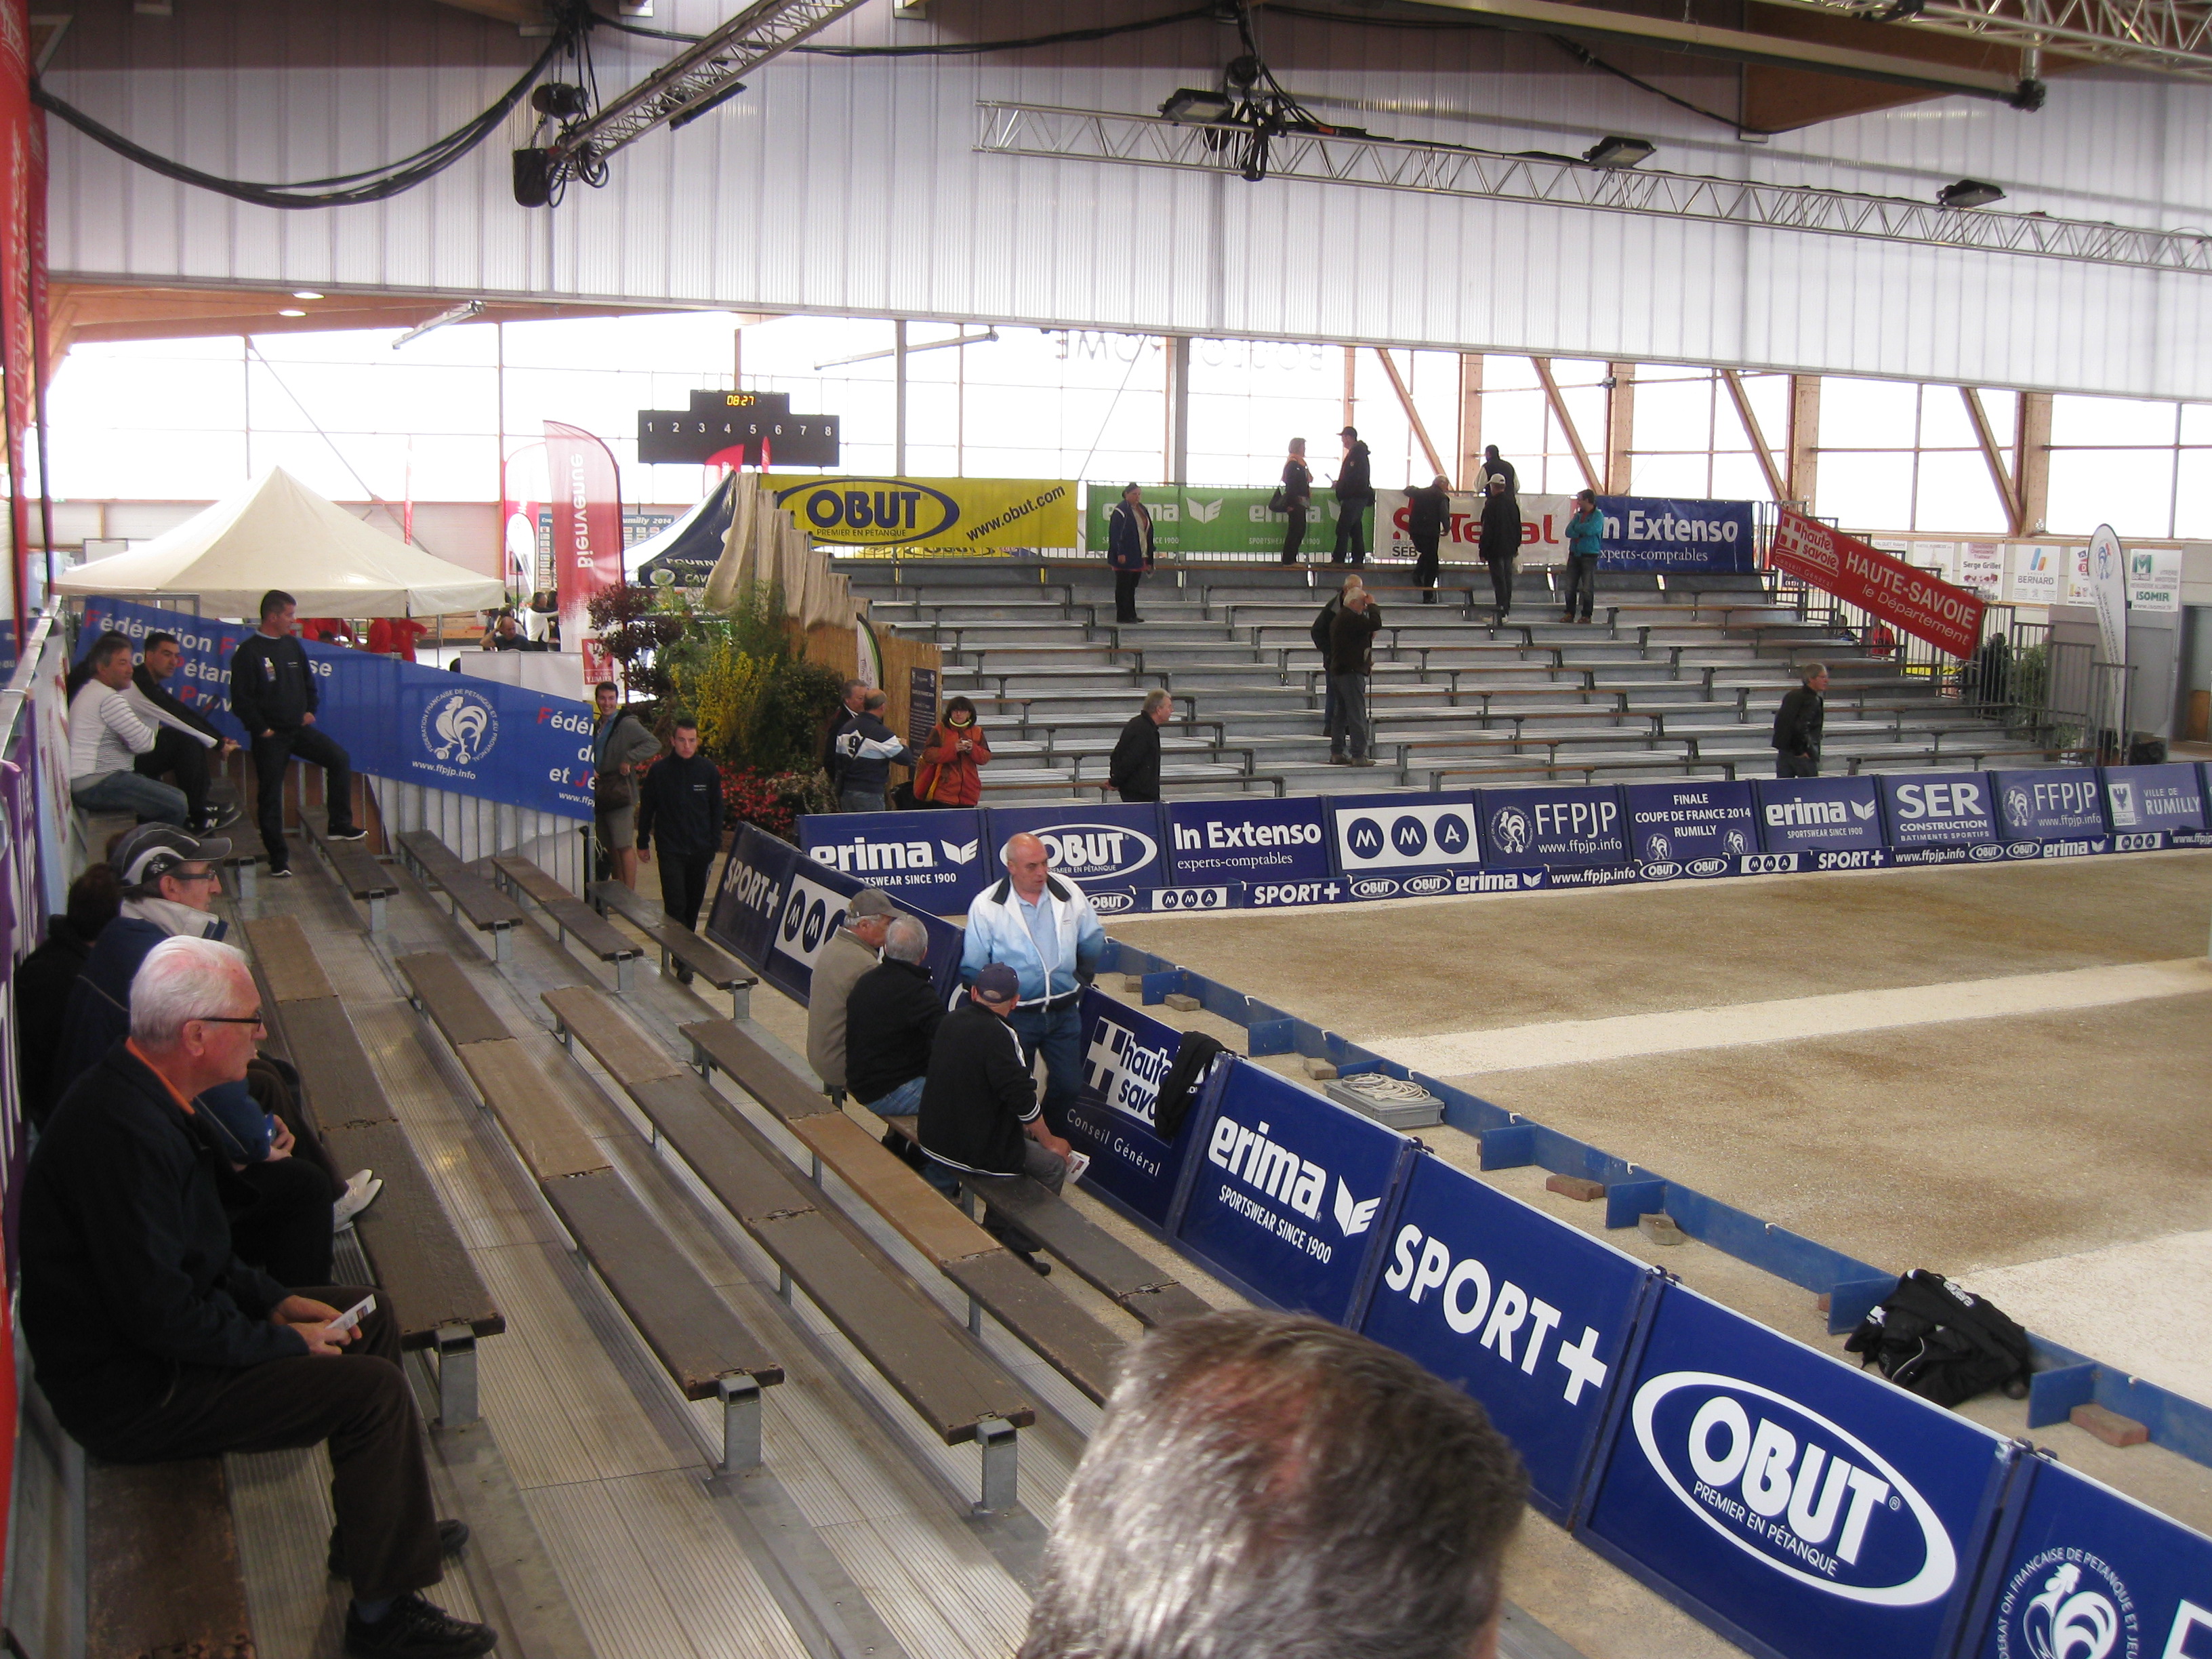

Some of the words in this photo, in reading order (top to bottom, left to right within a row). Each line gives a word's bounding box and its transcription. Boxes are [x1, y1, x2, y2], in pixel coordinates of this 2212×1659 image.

[726, 395, 755, 406] 08:27
[647, 422, 653, 432] 1
[672, 422, 680, 432] 2
[698, 422, 705, 432] 3
[724, 424, 731, 433] 4
[750, 424, 756, 434] 5
[775, 425, 781, 434] 6
[800, 426, 807, 435] 7
[825, 426, 832, 436] 8
[806, 489, 920, 528] OBUT
[966, 485, 1066, 541] www.obut.com
[623, 516, 650, 525] umilly
[1450, 513, 1559, 544] Teal
[1628, 510, 1738, 543] Extenso
[816, 529, 851, 537] PREMIER
[865, 528, 906, 537] PÉTANQUE
[1800, 525, 1832, 549] haute
[1392, 546, 1418, 557] SEB
[1598, 548, 1708, 564] xperts-comptables
[1802, 543, 1838, 568] savoie
[1963, 561, 1981, 569] Serge
[2018, 576, 2054, 586] BERNARD
[1845, 551, 1976, 630] HAUTE-SAVOIE
[2135, 591, 2169, 602] ISOMIR
[1862, 583, 1874, 597] le
[1877, 591, 1970, 645] Département
[412, 760, 476, 780] www.ffpjp.info
[549, 767, 570, 784] et
[1673, 794, 1708, 804] FINALE
[2034, 781, 2096, 813] FFPJP
[2143, 788, 2165, 797] VILLE
[2168, 787, 2177, 796] DE
[1897, 783, 1985, 819] SER
[2145, 796, 2200, 815] RUMILLY
[1534, 802, 1616, 838] FFPJP
[1635, 811, 1668, 823] COUPE
[1671, 811, 1683, 822] DE
[1684, 809, 1725, 821] FRANCE
[1727, 808, 1750, 818] 2014
[1766, 797, 1847, 826] erima
[2038, 813, 2101, 827] www.ffpjp.info
[1674, 825, 1717, 838] RUMILLY
[1787, 829, 1827, 838] SPORTSWEAR
[1830, 828, 1846, 836] SINCE
[1848, 827, 1863, 836] 1900
[1900, 821, 1987, 832] CONSTRUCTION
[1173, 822, 1202, 851] In
[1207, 821, 1322, 848] Extenso
[1901, 833, 1947, 841] BATIMENTS
[811, 837, 933, 872] erima
[1538, 838, 1622, 854] www.ffpjp.info
[1896, 844, 1965, 863] www.ffpjp.info
[1976, 846, 1997, 857] OBUT
[2013, 844, 2033, 855] OBUT
[2043, 839, 2087, 857] erima
[1177, 852, 1293, 870] experts-comptables
[1694, 861, 1719, 872] OBUT
[905, 874, 933, 884] SINCE
[934, 872, 957, 883] 1900
[1551, 867, 1635, 884] www.ffpjp.info
[1649, 864, 1673, 876] OBUT
[1360, 882, 1389, 894] OBUT
[1413, 878, 1441, 890] OBUT
[1456, 872, 1517, 891] erima
[1093, 897, 1122, 909] OBUT
[1067, 1108, 1110, 1144] Conseil
[1114, 1137, 1161, 1176] Général
[1208, 1115, 1327, 1221] erima
[1218, 1185, 1277, 1232] SPORTSWEAR
[1276, 1218, 1307, 1250] SINCE
[1306, 1236, 1332, 1265] 1900
[1688, 1396, 1889, 1566] OBUT
[1694, 1481, 1745, 1523] PREMIER
[1746, 1513, 1766, 1534] EN
[1767, 1524, 1839, 1578] PÉTANQUE
[2066, 1547, 2084, 1562] DE
[2083, 1552, 2134, 1612] PETANQUE
